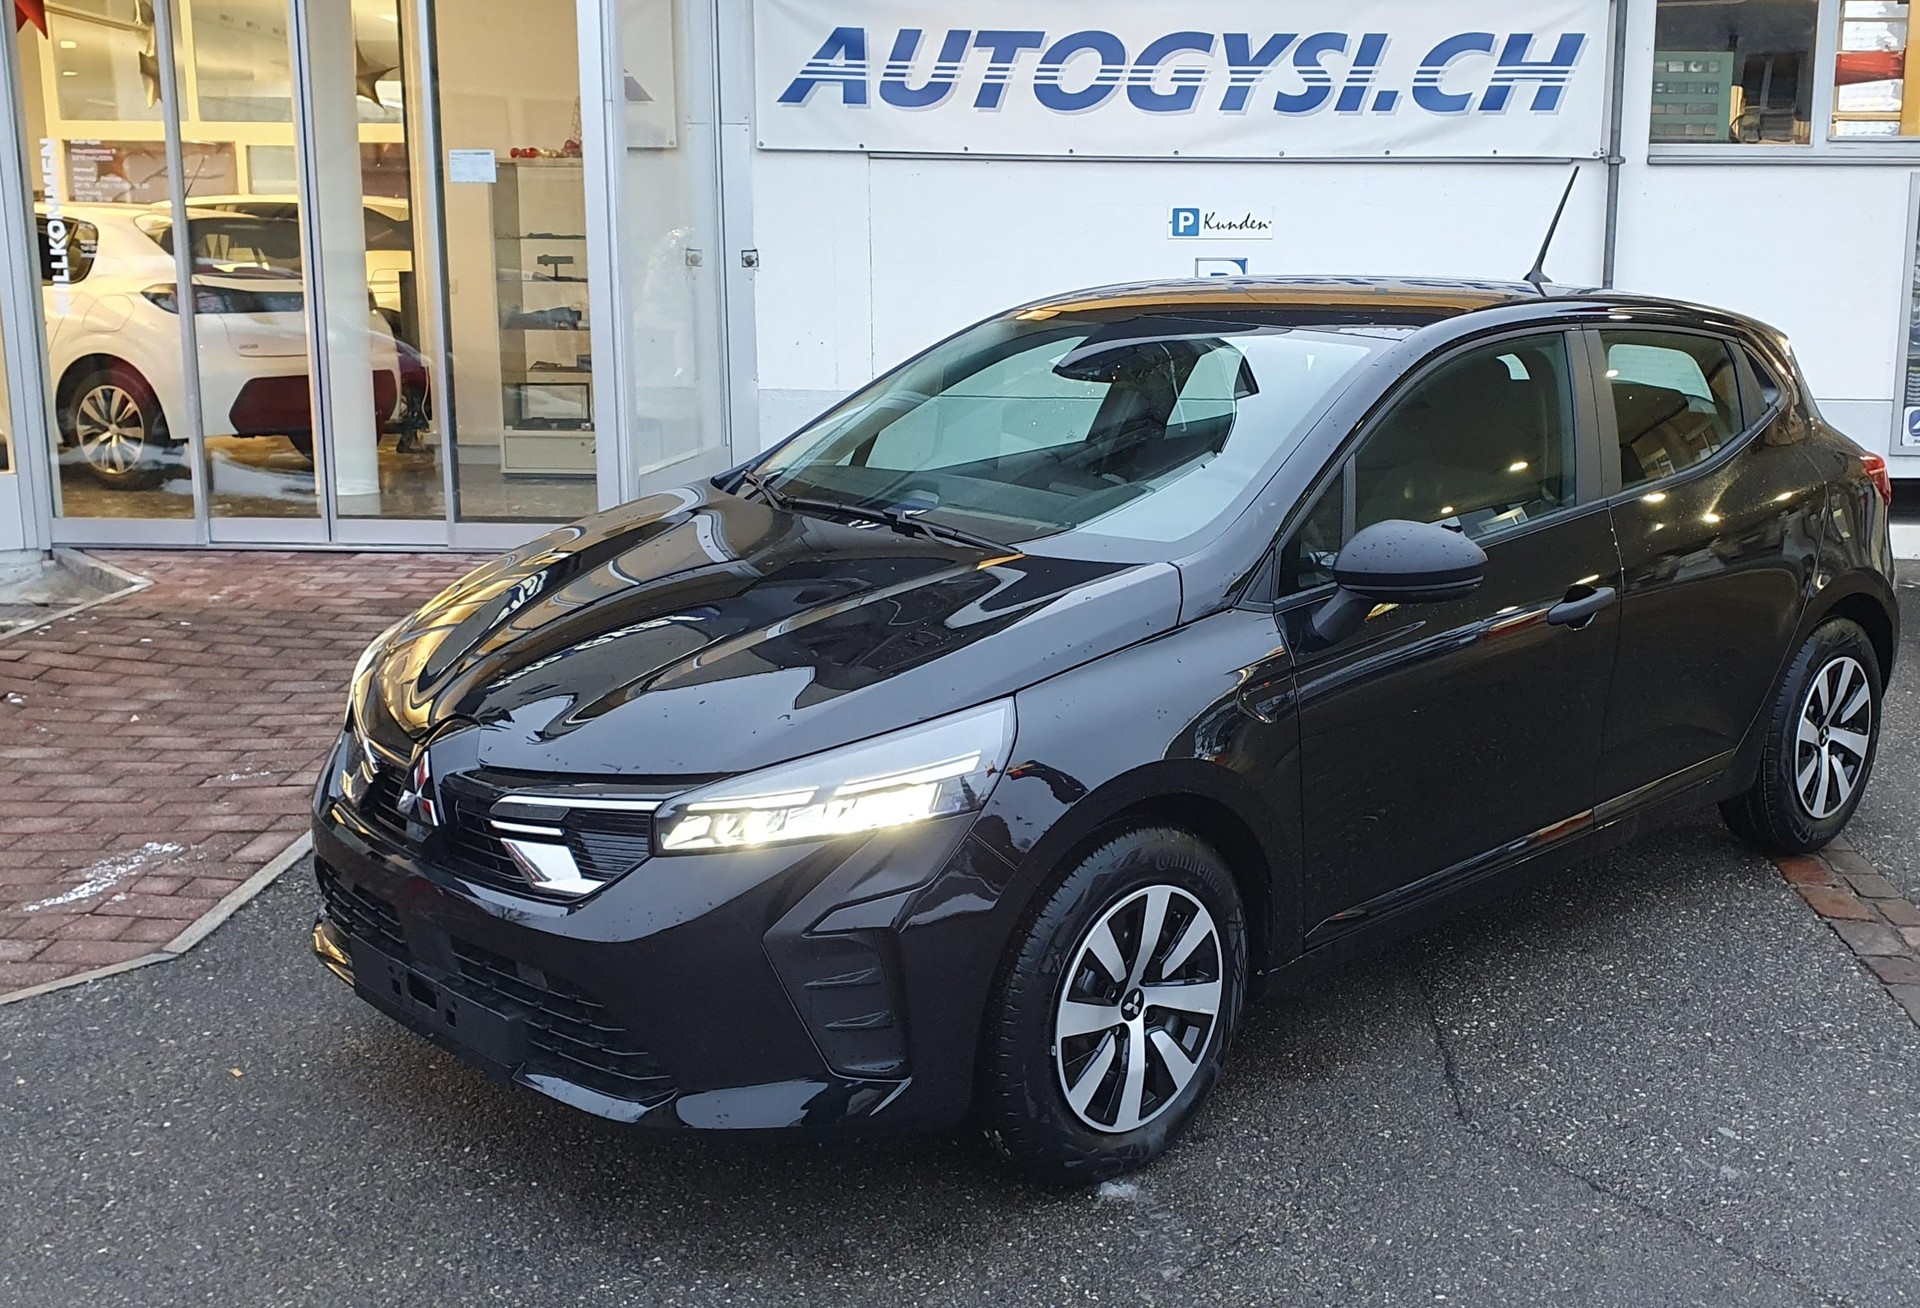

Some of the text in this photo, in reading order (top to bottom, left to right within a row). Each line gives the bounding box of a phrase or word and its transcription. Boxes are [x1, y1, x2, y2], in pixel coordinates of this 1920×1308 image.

[776, 26, 1588, 114] AUTOGYSI.CH
[39, 137, 71, 317] ILLKOMMEN
[1178, 211, 1268, 233] P Kunden
